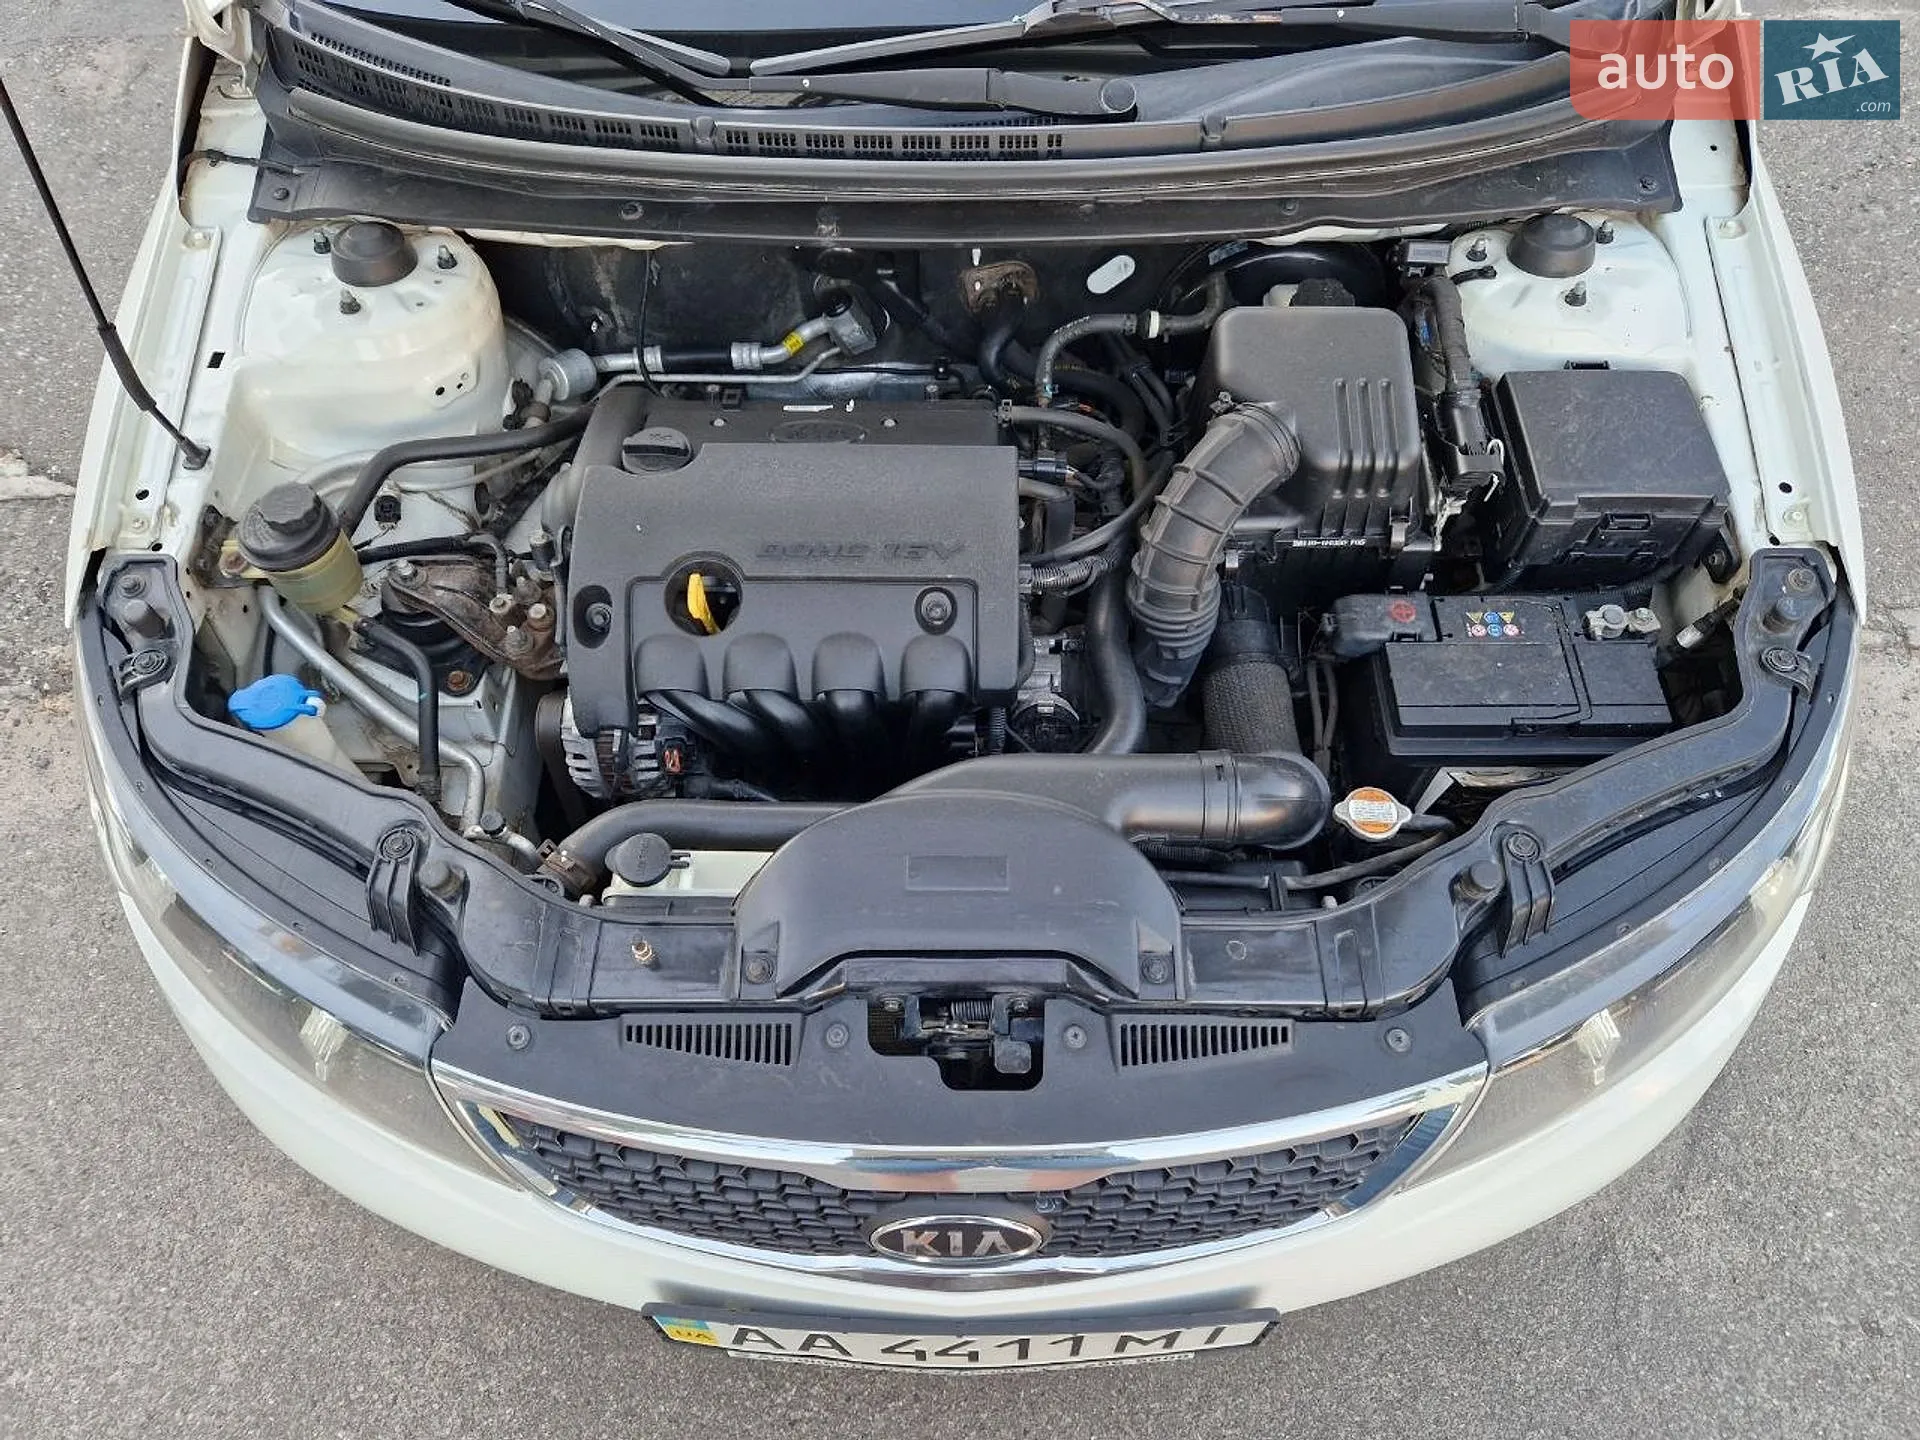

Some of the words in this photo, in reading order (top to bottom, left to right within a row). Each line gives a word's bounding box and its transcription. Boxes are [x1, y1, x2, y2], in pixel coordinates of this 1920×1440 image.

[900, 1230, 1017, 1257] KIA
[731, 1327, 854, 1357] AA
[881, 1335, 1085, 1362] 4411
